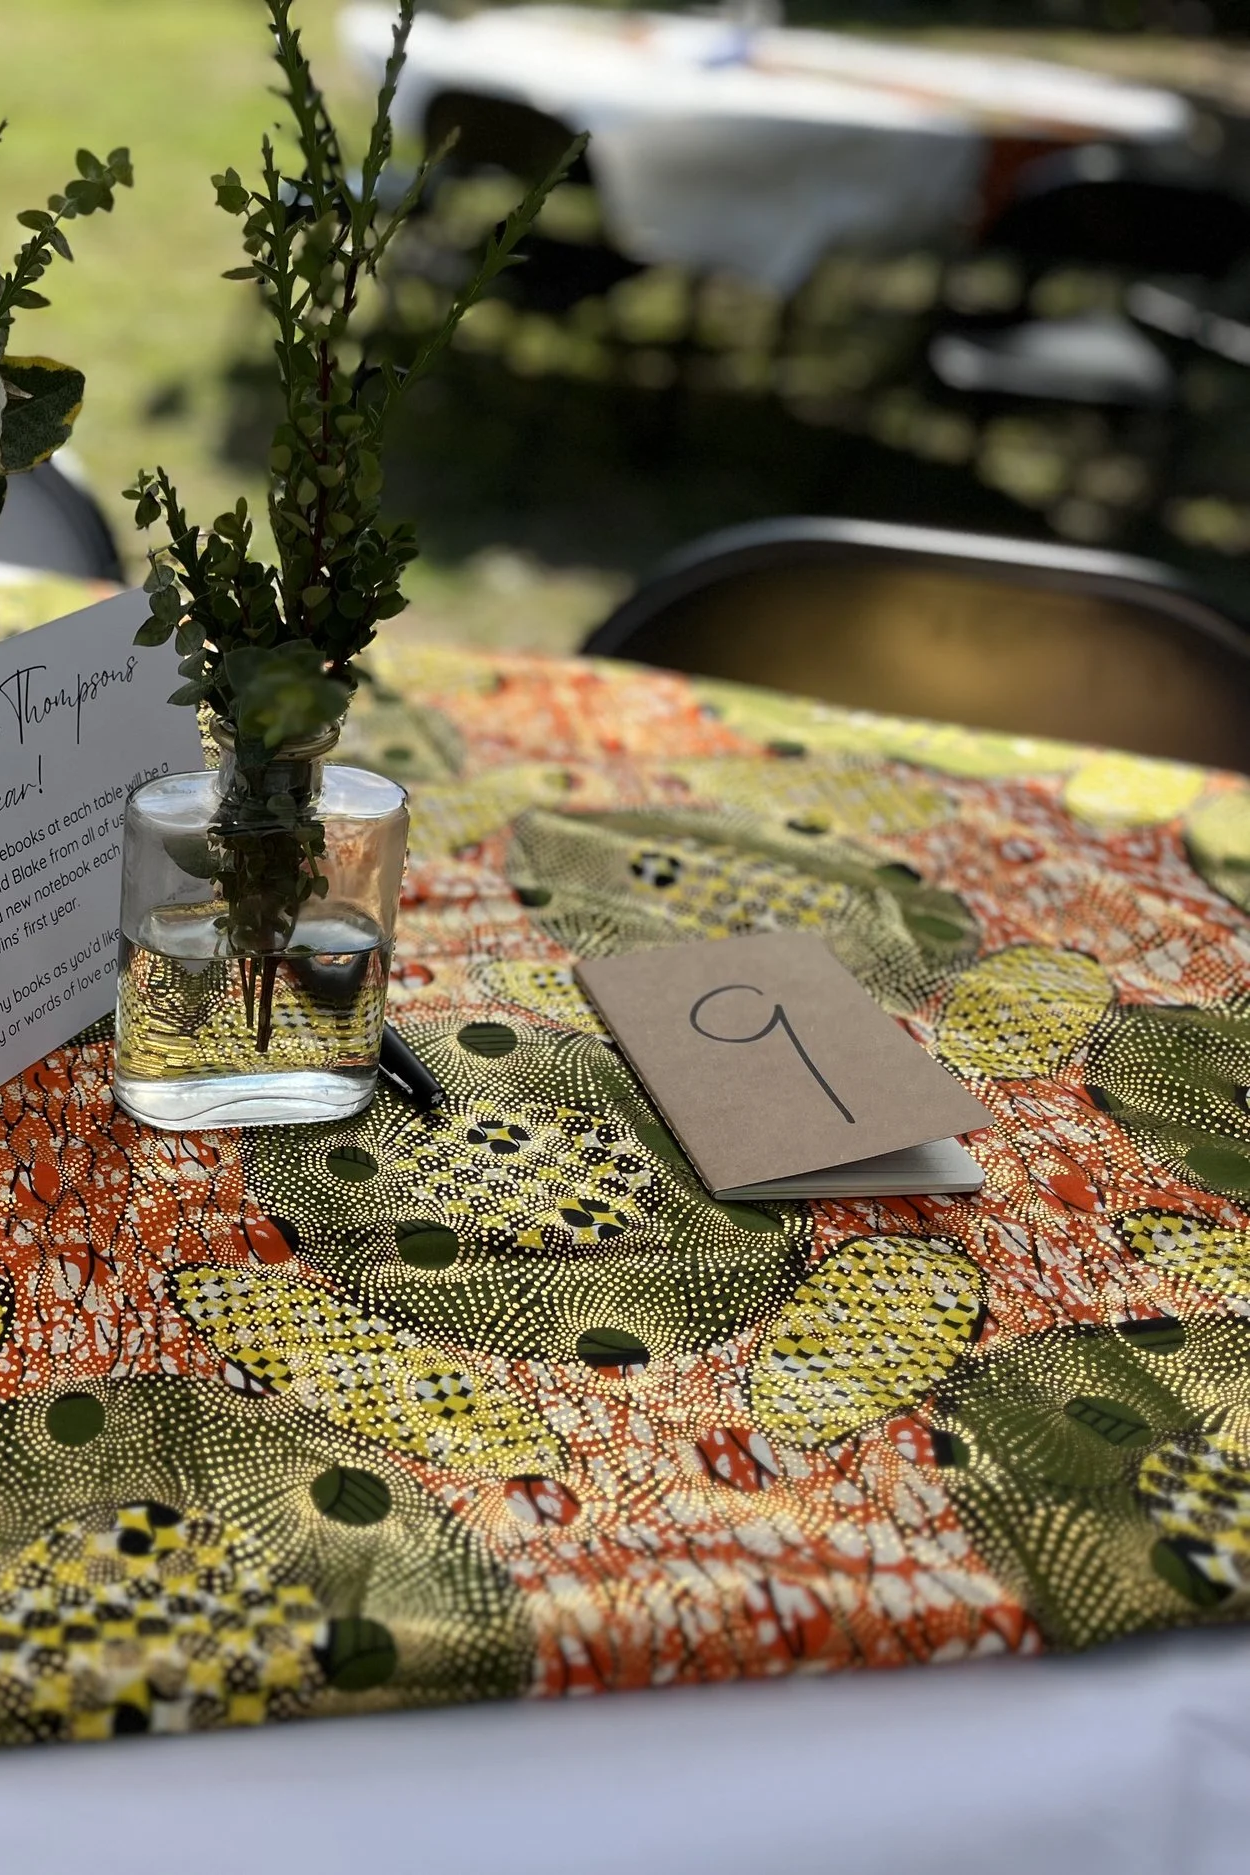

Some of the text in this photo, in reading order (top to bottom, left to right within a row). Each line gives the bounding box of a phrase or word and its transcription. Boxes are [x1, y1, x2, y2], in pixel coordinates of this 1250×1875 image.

[47, 818, 62, 836] at
[62, 801, 93, 828] each
[92, 786, 124, 811] table
[160, 761, 169, 771] a
[5, 894, 31, 920] new
[33, 859, 92, 903] notebook
[92, 842, 121, 869] each
[9, 857, 48, 885] Blake
[48, 839, 80, 865] from
[81, 826, 96, 847] all
[96, 817, 110, 838] of
[22, 913, 49, 939] first
[50, 897, 81, 925] year.
[8, 1018, 22, 1037] or
[23, 993, 62, 1027] words
[62, 977, 76, 1001] of
[76, 968, 102, 993] love
[103, 957, 119, 975] an
[12, 972, 52, 1005] books
[52, 961, 69, 979] as
[689, 984, 856, 1124] 9
